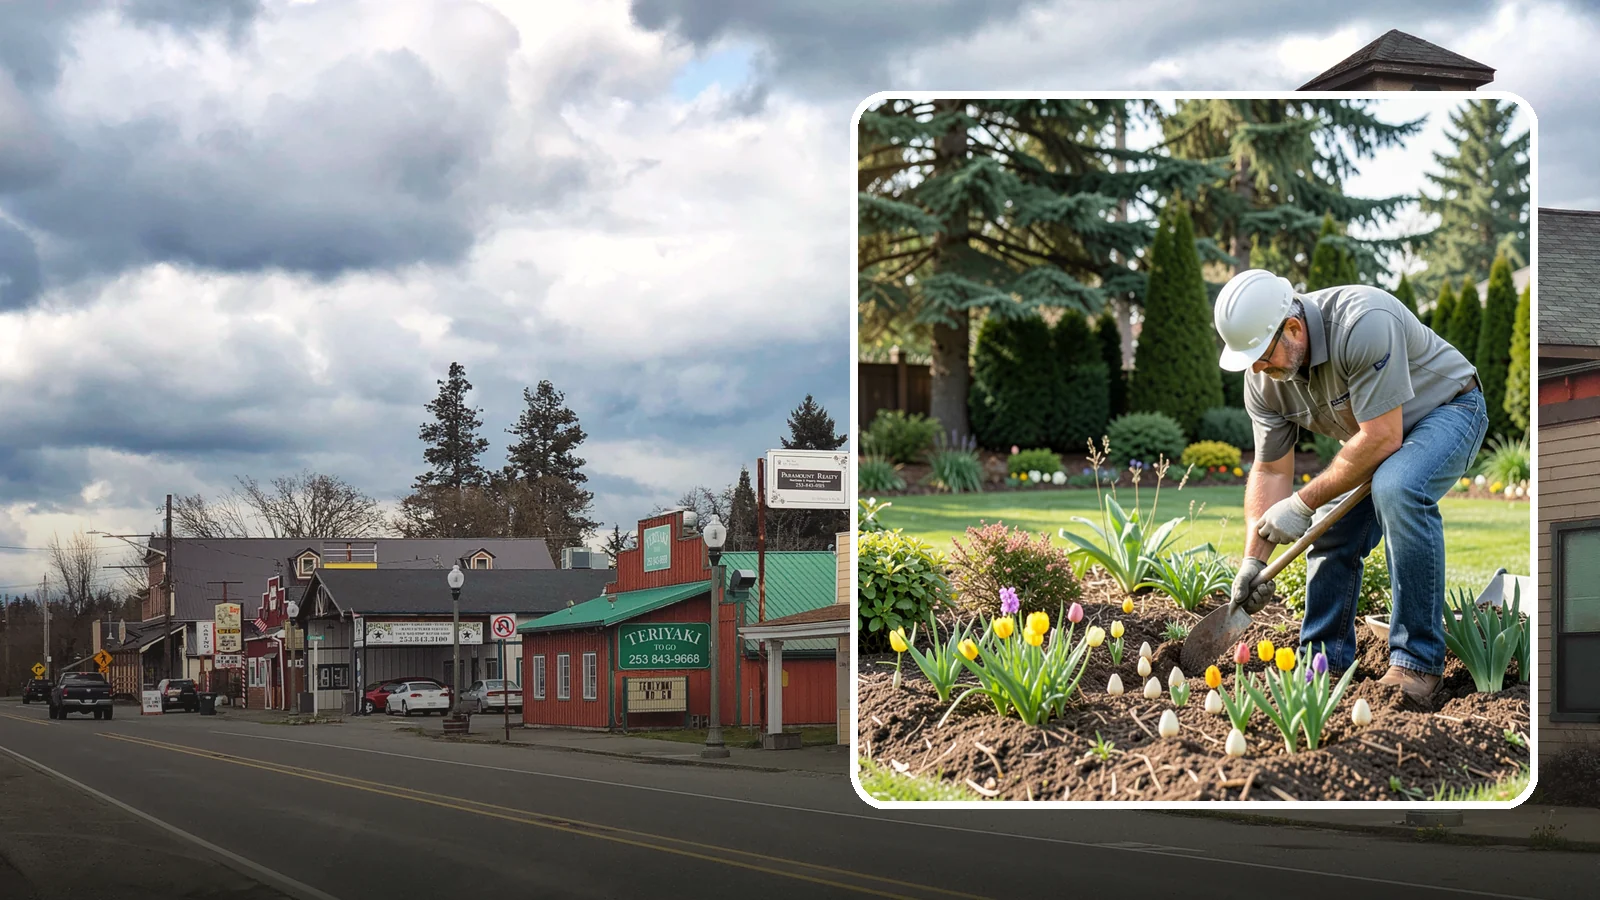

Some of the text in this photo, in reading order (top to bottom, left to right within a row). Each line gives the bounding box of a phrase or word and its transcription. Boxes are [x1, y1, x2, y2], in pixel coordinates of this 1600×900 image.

[817, 473, 839, 481] REALTY
[399, 636, 448, 644] 253.843.3100
[625, 627, 703, 646] TERIYAKI
[629, 653, 700, 665] 253 843-9668
